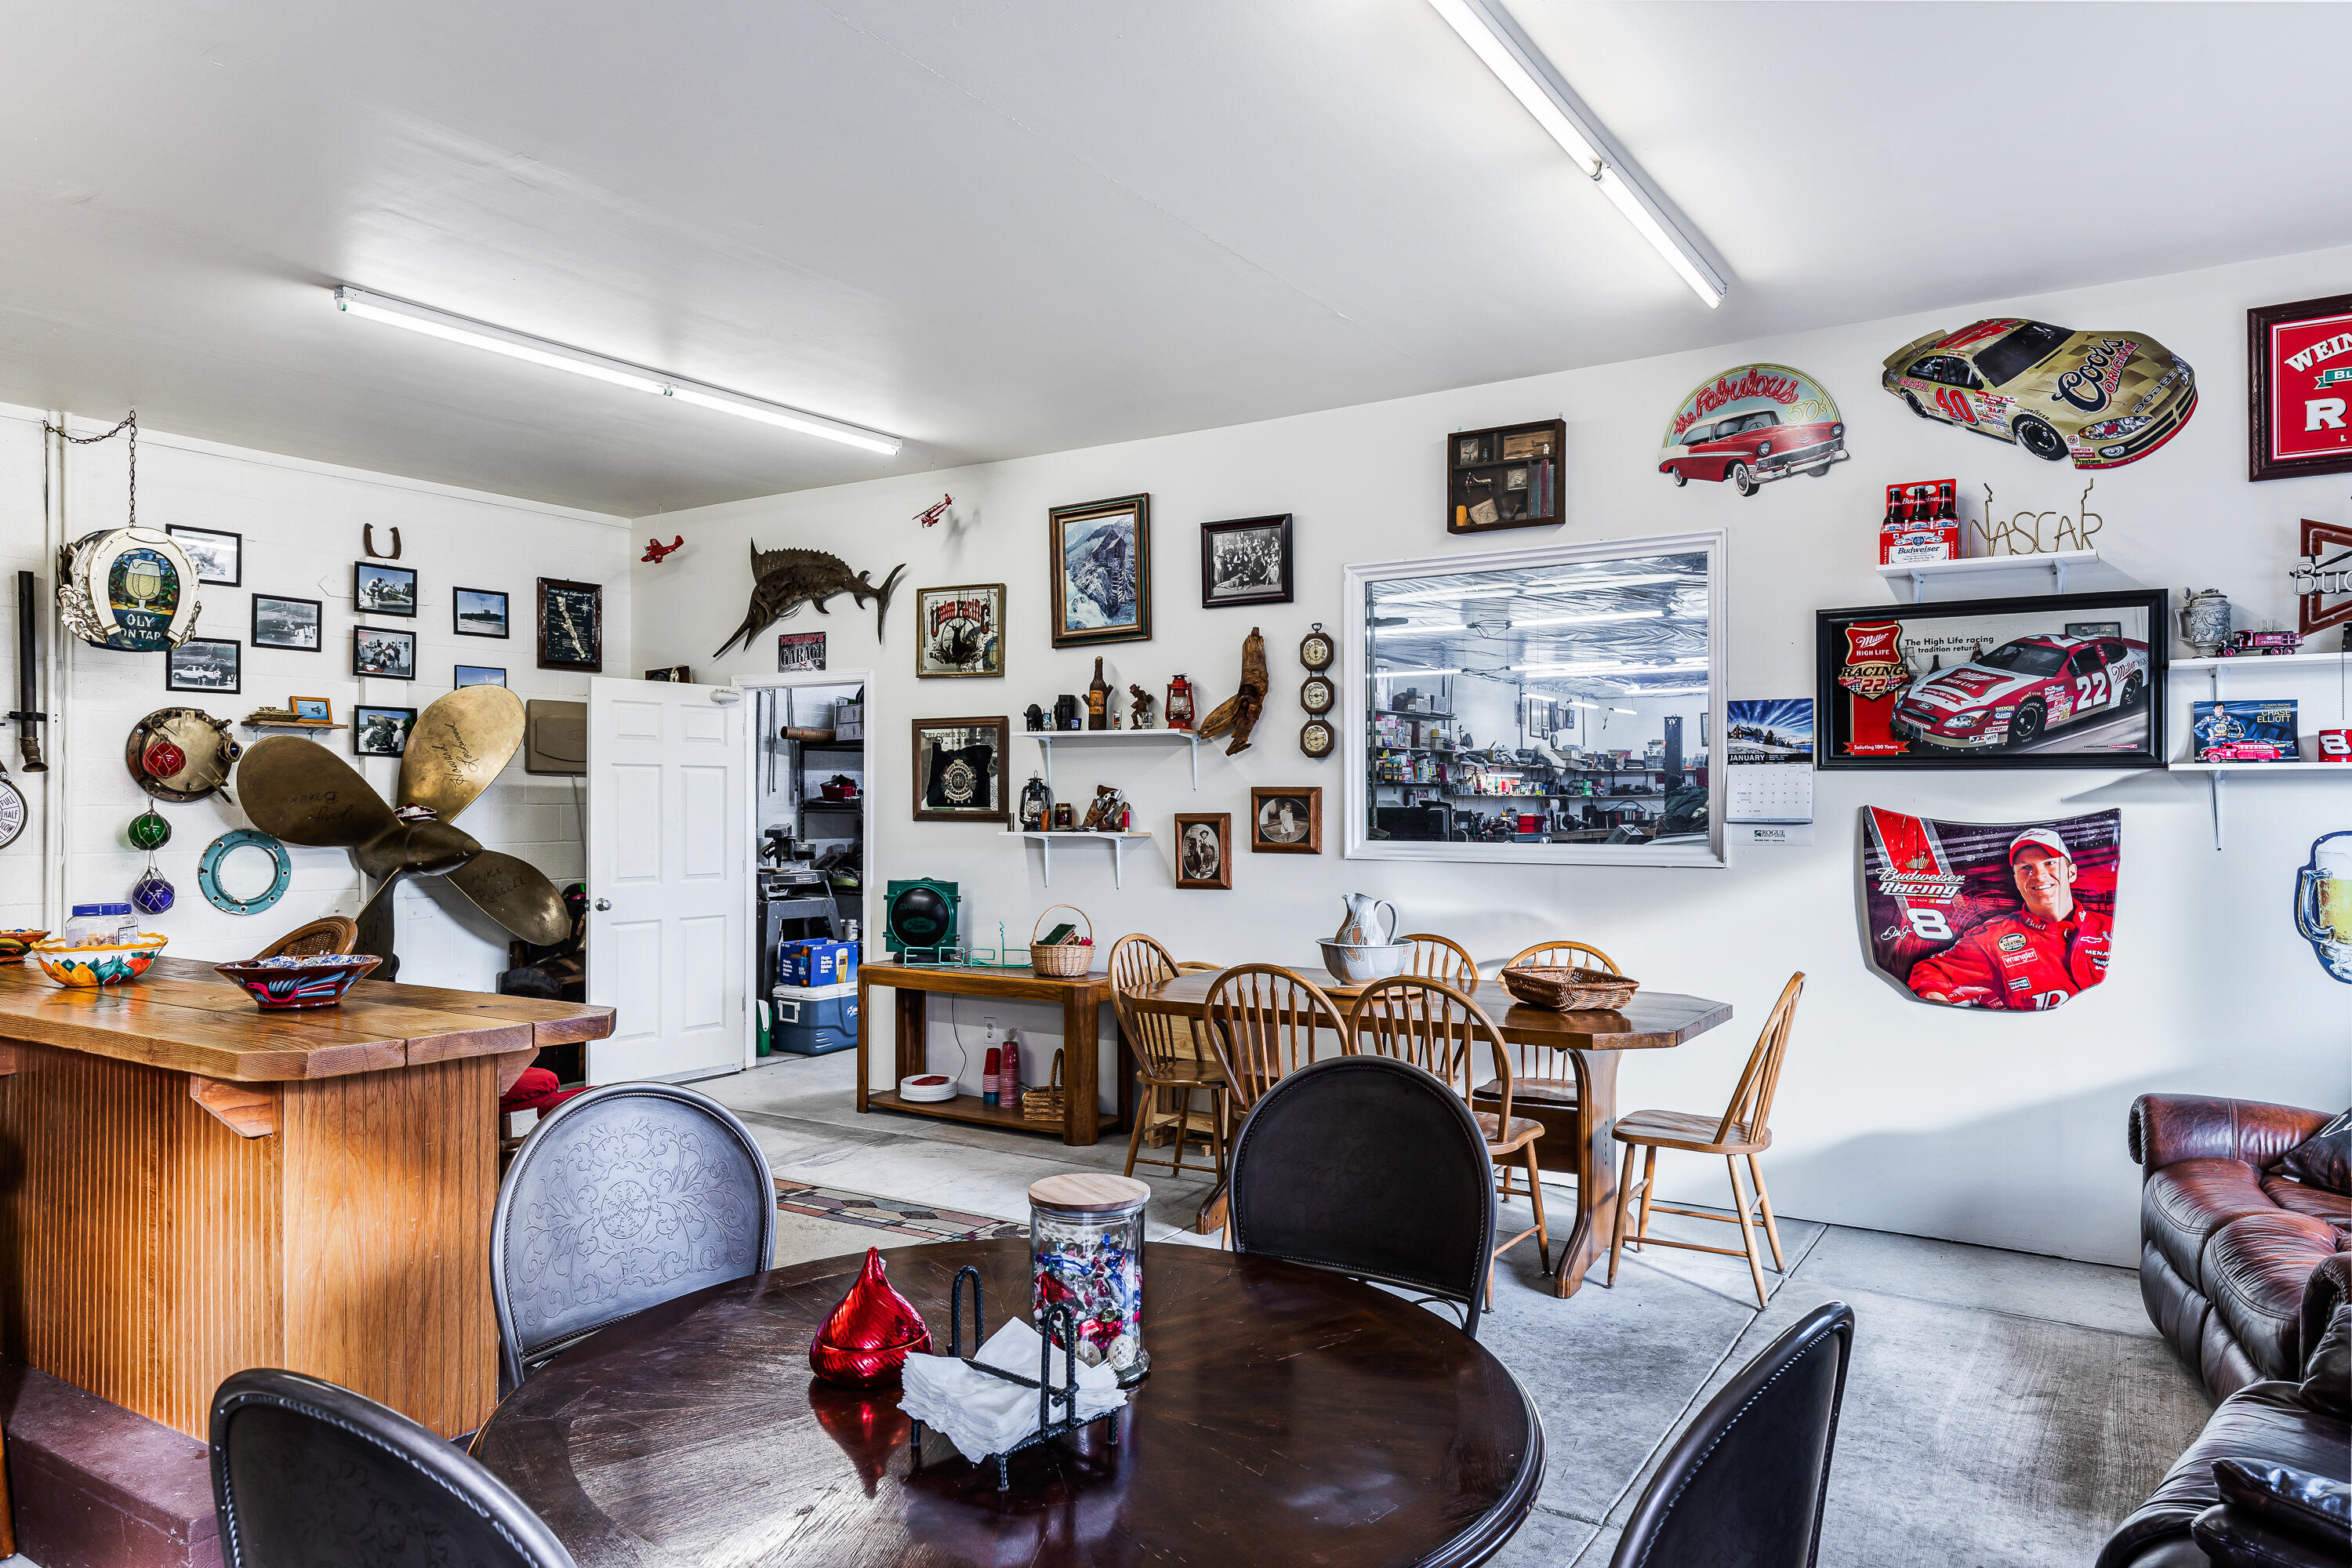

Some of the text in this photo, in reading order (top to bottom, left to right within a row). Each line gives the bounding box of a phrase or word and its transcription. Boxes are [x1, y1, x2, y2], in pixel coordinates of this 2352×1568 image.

[2103, 341, 2142, 394] ORIGINAL
[1898, 376, 1932, 392] ORIGINAL
[2051, 338, 2127, 414] Coors
[2131, 370, 2178, 415] DODGE
[1673, 368, 1798, 435] the Fabulous
[1934, 385, 1980, 426] 40
[1785, 397, 1828, 424] 50's
[2103, 423, 2118, 435] 40
[1896, 546, 1940, 558] Budweiser
[125, 613, 155, 627] OLY
[139, 630, 162, 640] TAP
[781, 633, 824, 645] HOWARD'S
[1856, 633, 1889, 649] Miller
[1924, 637, 1944, 647] High
[779, 643, 825, 666] GARAGE
[1842, 666, 1906, 678] RACING
[2111, 661, 2136, 684] Miller
[1860, 677, 1887, 694] 22
[1961, 681, 1980, 690] LIFE
[2076, 672, 2107, 711] 22
[2320, 734, 2352, 755] 8
[0, 795, 16, 806] FULL
[3, 810, 18, 819] HALF
[1875, 867, 1965, 881] Budweiser
[1906, 908, 1954, 940] 8
[2025, 917, 2046, 930] Bud
[2003, 950, 2035, 964] Wrangler
